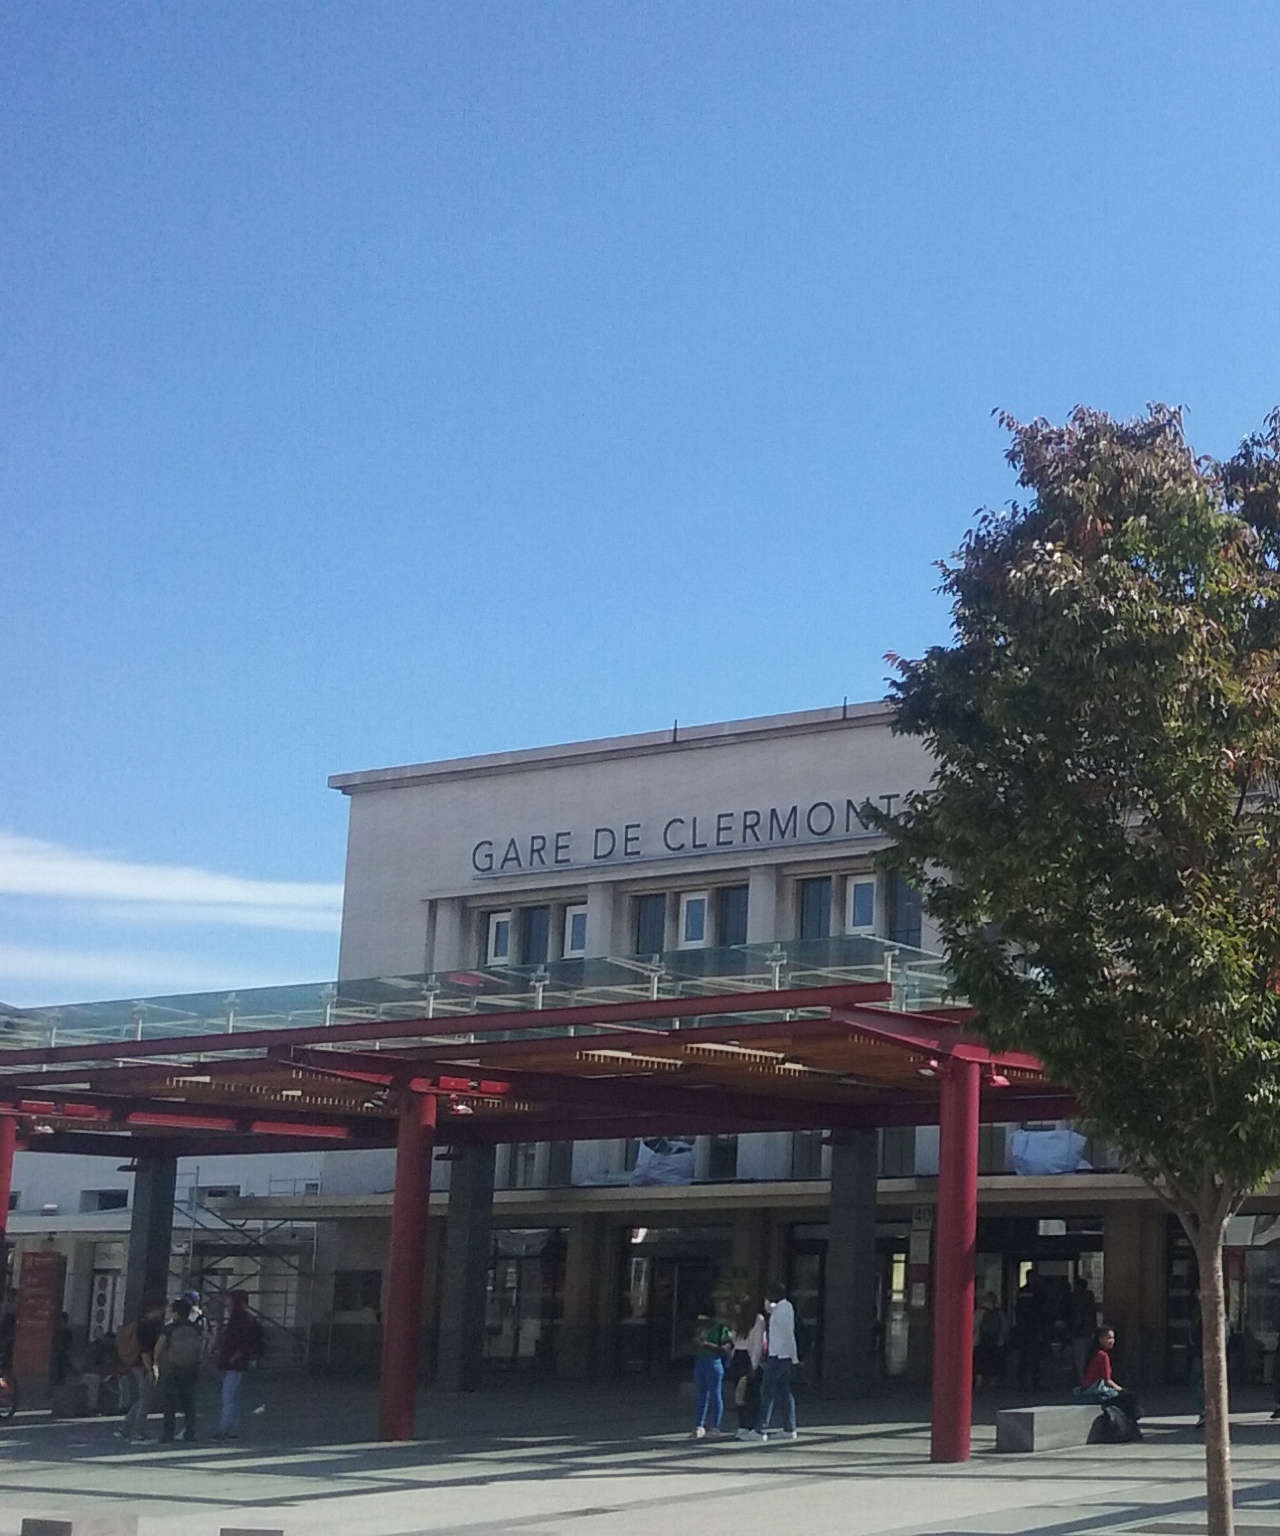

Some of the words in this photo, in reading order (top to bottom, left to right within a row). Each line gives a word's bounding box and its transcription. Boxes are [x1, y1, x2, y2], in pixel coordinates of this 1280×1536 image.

[472, 831, 571, 872] GARE
[593, 823, 641, 860] DE
[663, 794, 900, 852] CLERMONT
